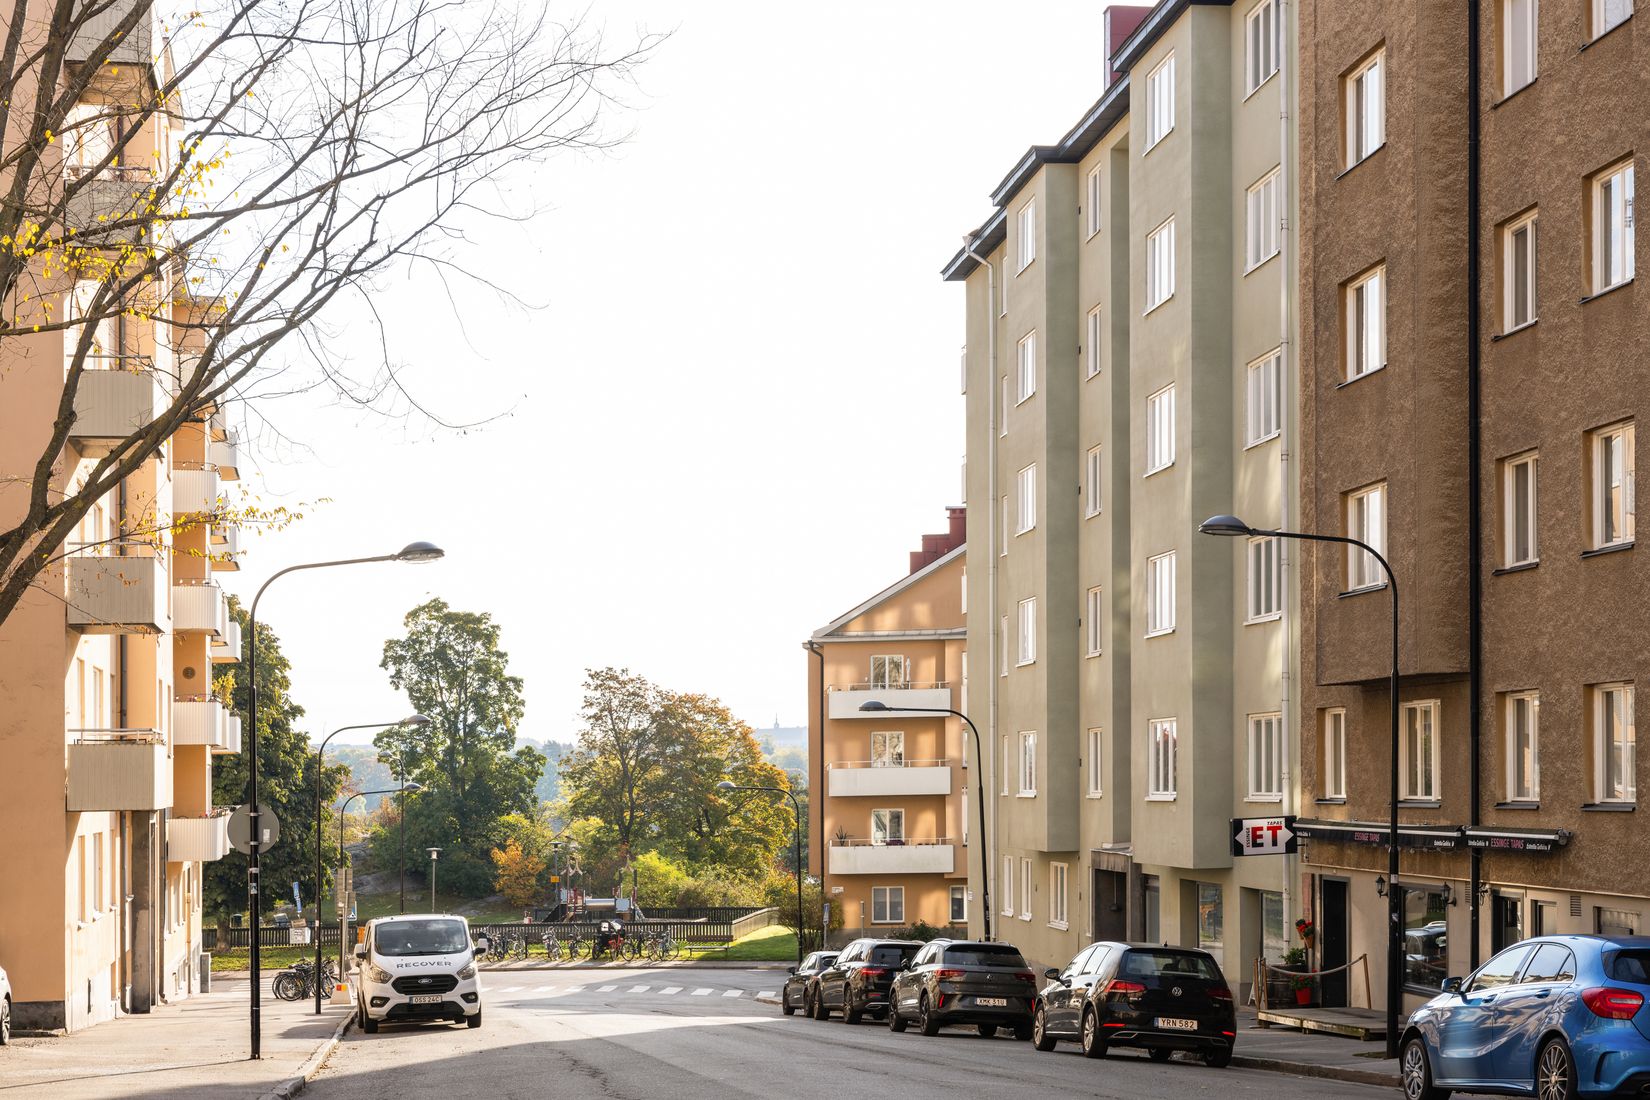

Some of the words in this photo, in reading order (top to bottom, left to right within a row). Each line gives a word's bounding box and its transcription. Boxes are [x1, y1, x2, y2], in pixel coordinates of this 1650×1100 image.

[1251, 825, 1283, 848] ET
[396, 961, 452, 969] RECOVER
[1161, 1019, 1177, 1027] YRN
[1178, 1020, 1195, 1028] 582
